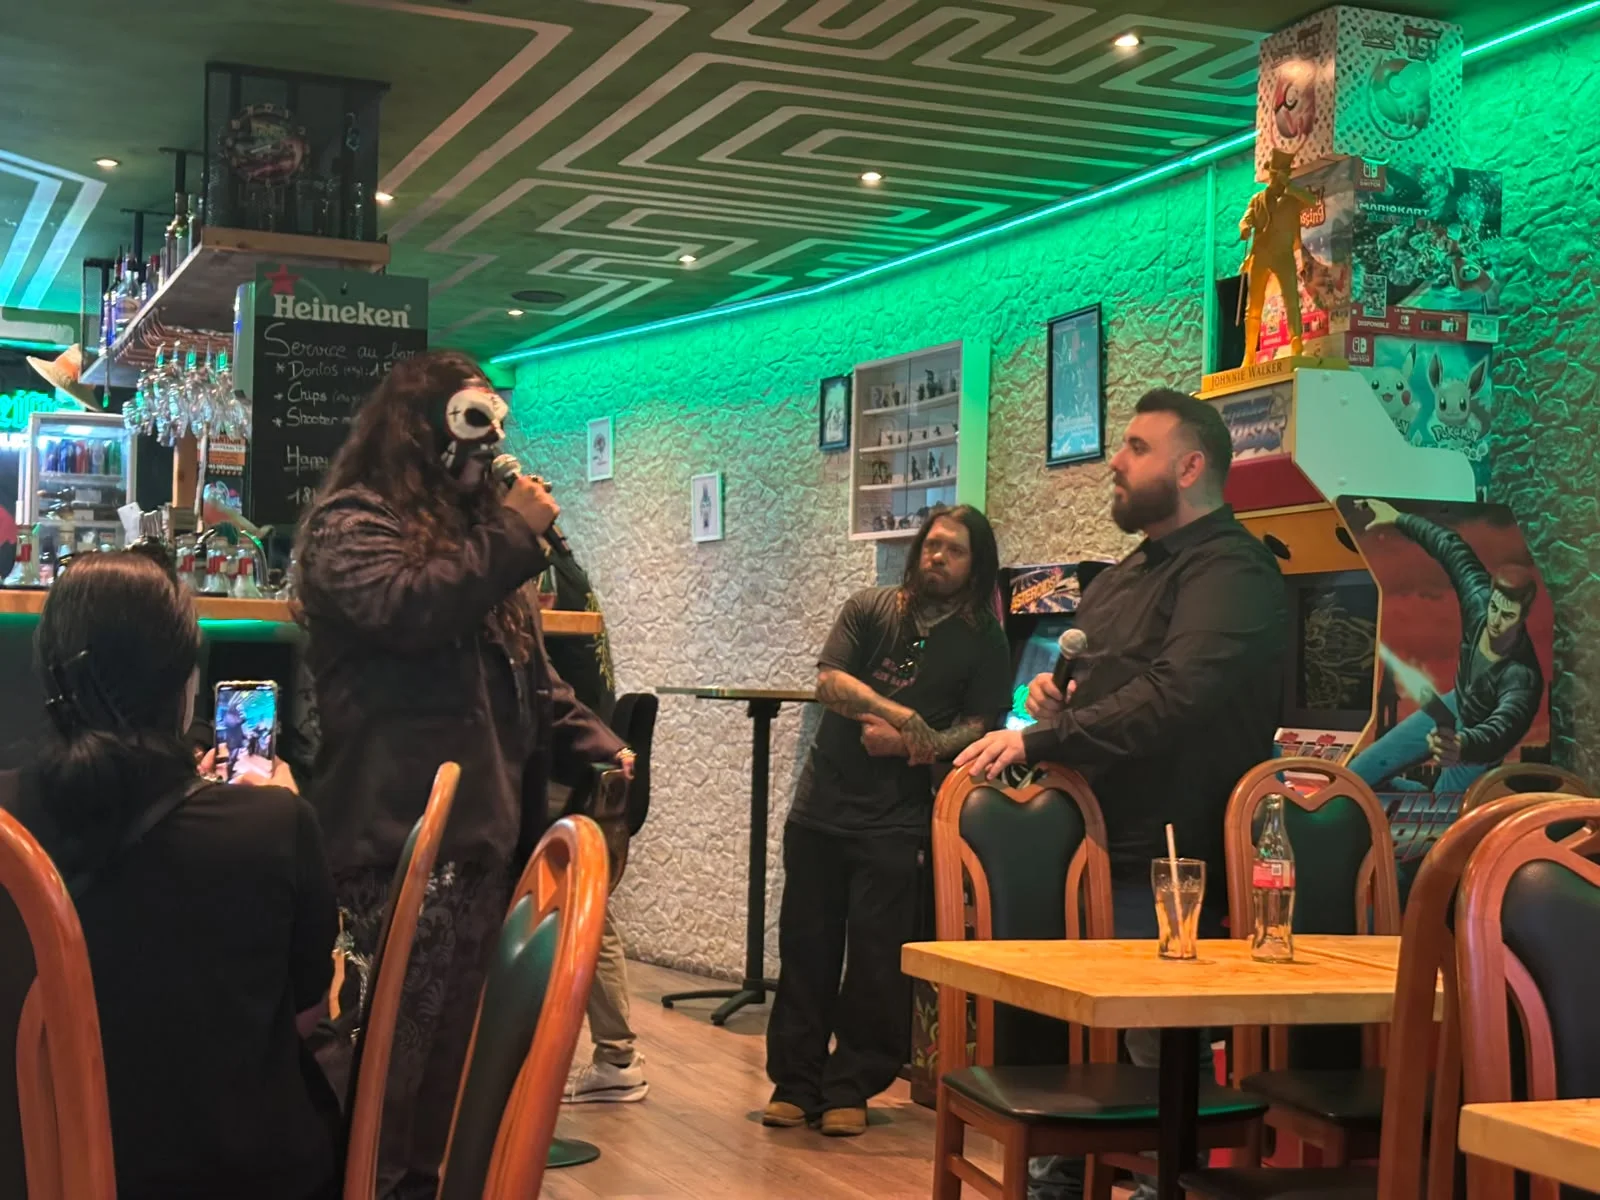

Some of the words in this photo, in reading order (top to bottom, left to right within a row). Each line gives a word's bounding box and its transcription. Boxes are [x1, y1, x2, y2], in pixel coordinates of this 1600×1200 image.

[1407, 35, 1438, 61] 151
[272, 294, 410, 328] Heineken
[263, 321, 347, 359] Service
[357, 345, 379, 360] au
[1211, 371, 1245, 389] JOHNNIE
[1248, 362, 1283, 379] WALKER
[286, 381, 328, 407] Chips
[285, 406, 339, 427] Shooter
